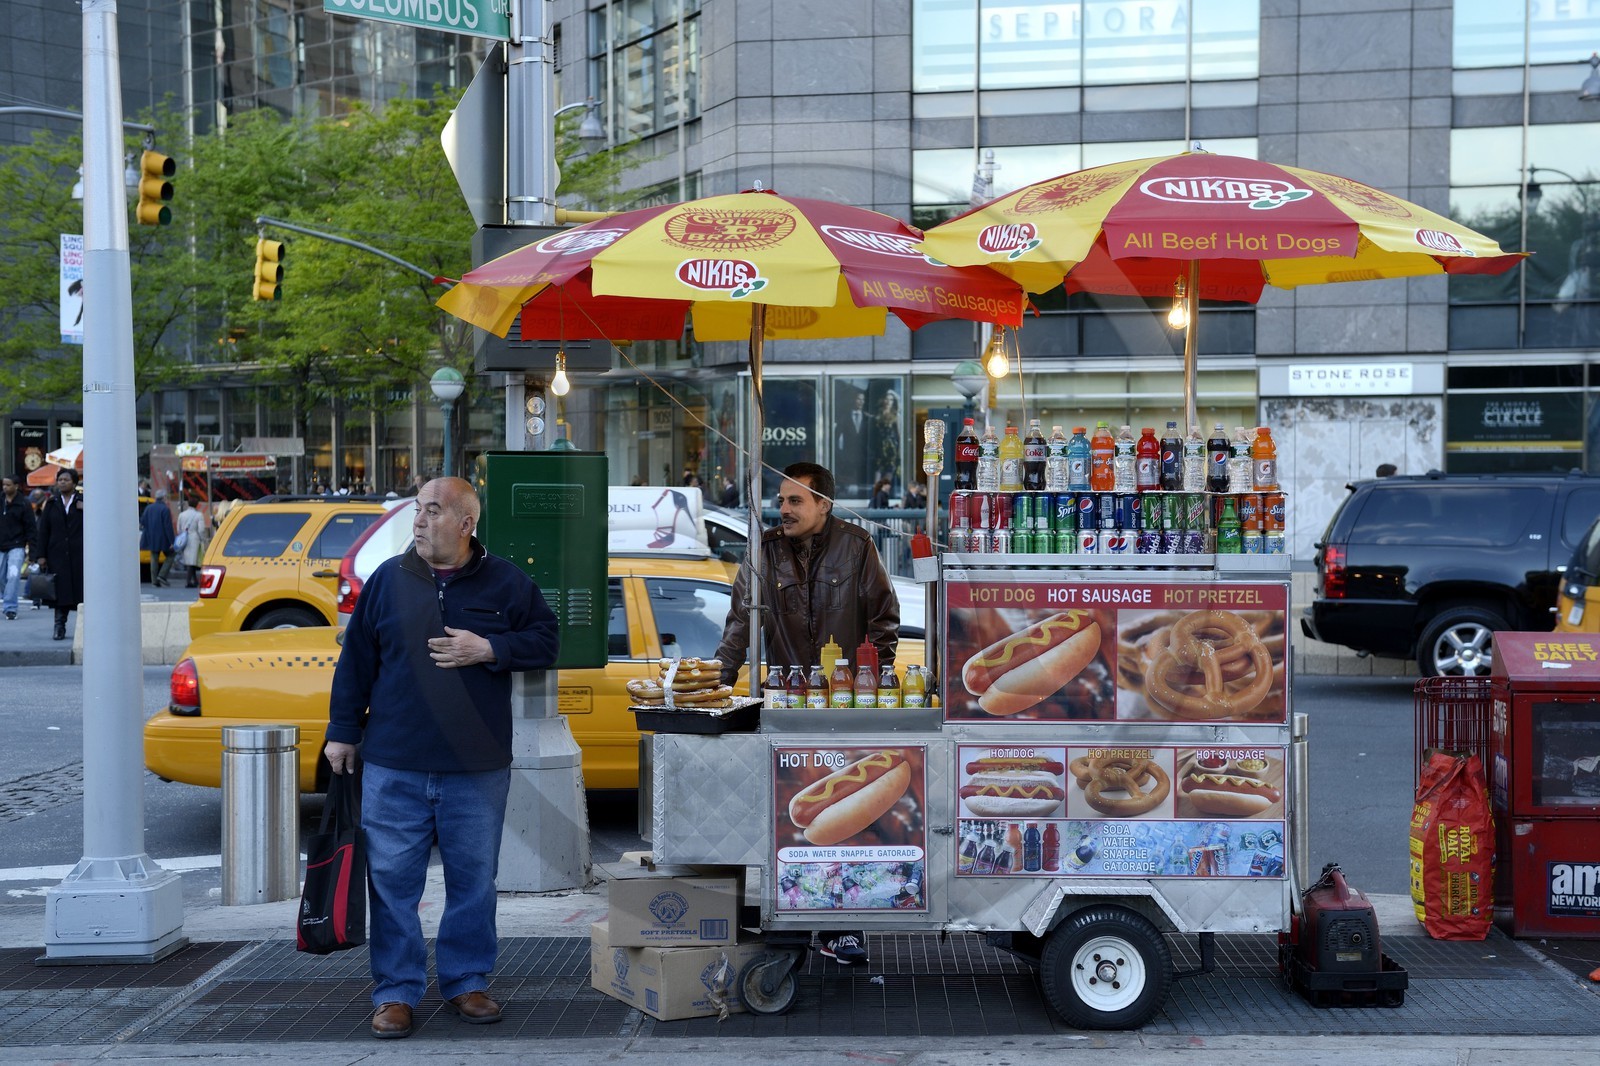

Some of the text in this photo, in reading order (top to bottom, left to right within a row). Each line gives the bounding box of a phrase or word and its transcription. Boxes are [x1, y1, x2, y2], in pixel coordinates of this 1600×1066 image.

[989, 4, 1188, 39] SEPHORA
[1166, 180, 1272, 199] NIKAS
[693, 214, 788, 226] GOLDEN
[687, 232, 780, 241] BRAND
[985, 224, 1030, 249] NIKAS
[1124, 232, 1341, 253] All Beef Hot Dogs
[687, 260, 748, 286] NIKAS
[863, 280, 1018, 317] All Beef Sausages
[1292, 367, 1409, 380] STONE ROSE
[1483, 411, 1542, 424] CIRCLE
[20, 429, 44, 437] Cartier
[762, 427, 807, 441] BOSS
[1025, 448, 1044, 457] Coke
[221, 456, 266, 466] Fresh Juices
[970, 588, 1263, 604] HOT DOG HOT SAUSAGE HOT PRETZEL
[1534, 643, 1593, 652] FREE
[1534, 651, 1598, 661] DAILY
[990, 749, 1034, 759] HOT DOG
[1088, 749, 1154, 760] HOT PRETZEL
[1196, 750, 1265, 760] HOT SAUSAGE
[780, 753, 845, 768] HOT DOG
[1103, 825, 1130, 835] SODA
[1103, 837, 1136, 848] WATER
[1447, 830, 1459, 858] OAK
[1460, 825, 1471, 864] ROYAL
[813, 850, 837, 858] WATER
[877, 849, 916, 857] GATORADE
[1103, 849, 1147, 859] SNAPPLE
[1103, 861, 1155, 872] GATORADE
[1451, 872, 1460, 916] CHARCOAL
[1552, 895, 1600, 907] NEW YOR
